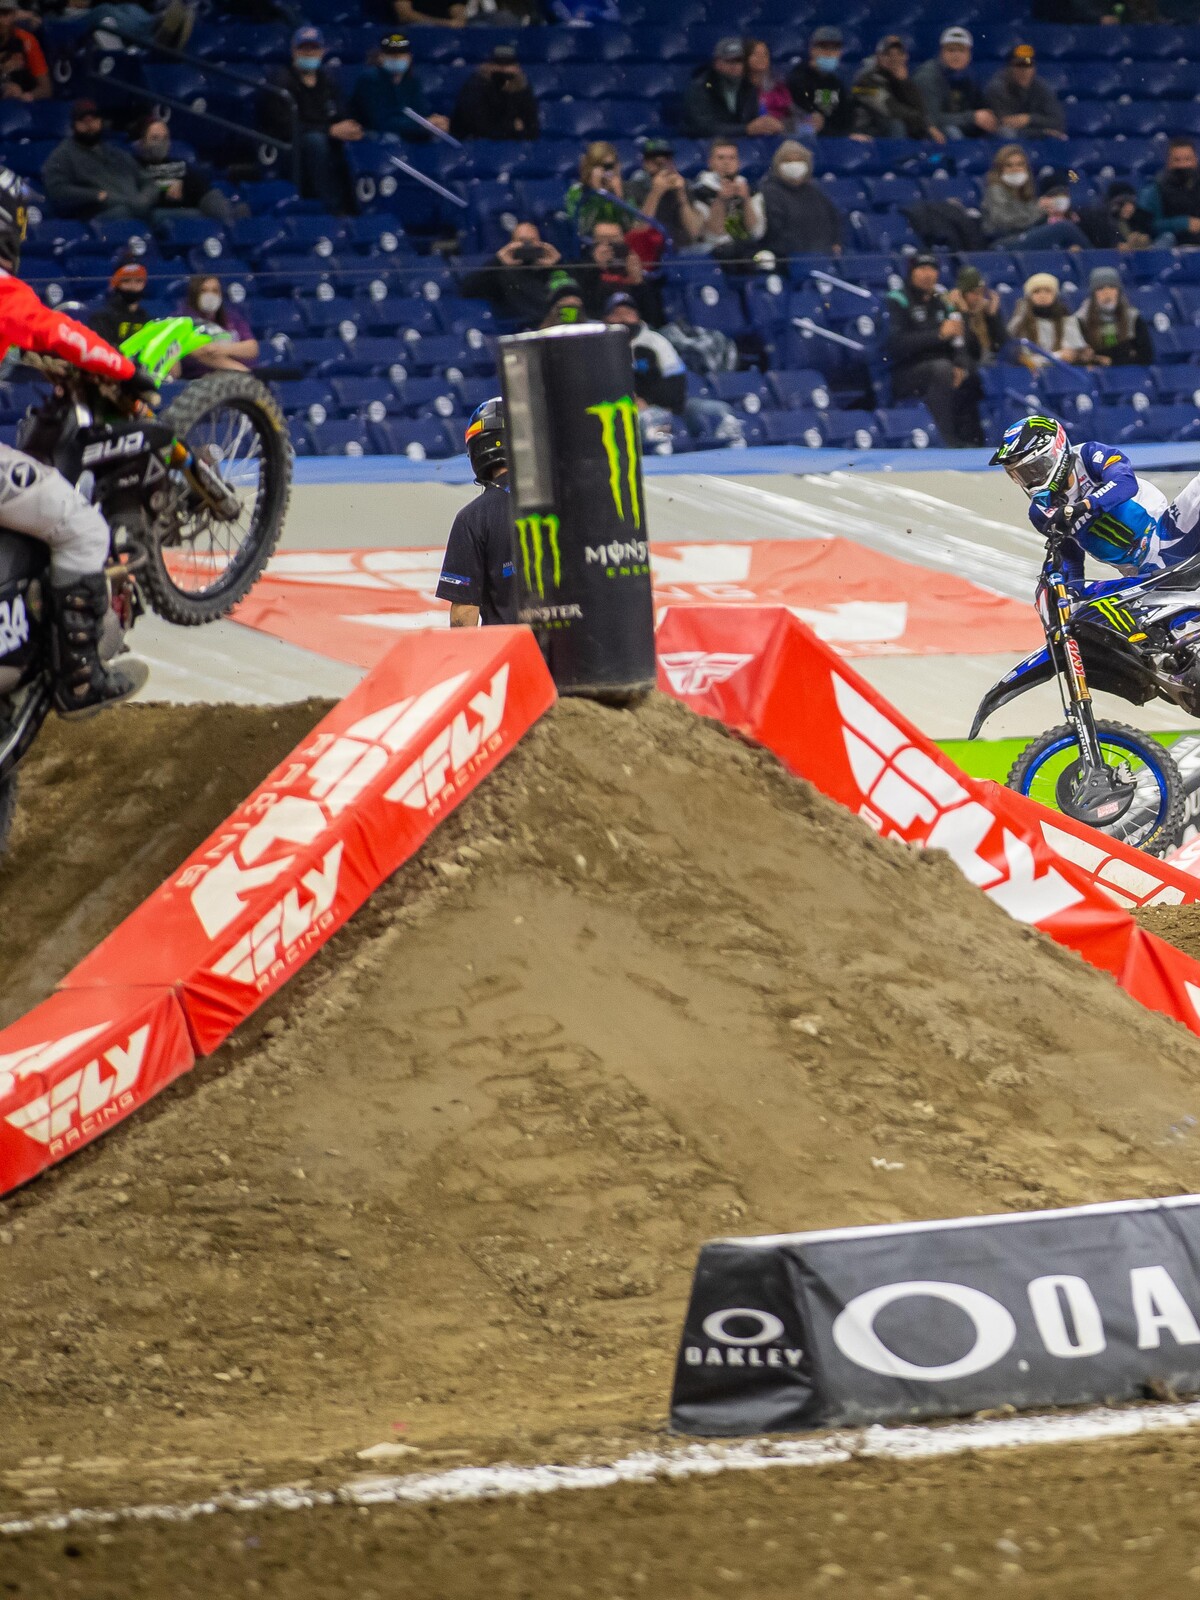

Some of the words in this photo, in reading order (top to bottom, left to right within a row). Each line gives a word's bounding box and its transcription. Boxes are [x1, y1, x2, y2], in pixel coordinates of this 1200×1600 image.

[82, 431, 145, 466] BUD
[1067, 639, 1086, 677] KYB
[383, 662, 510, 810] FLY
[427, 732, 504, 817] RACING
[1075, 716, 1091, 761] DUNLOP
[831, 669, 1086, 924] FLY
[211, 840, 344, 983] FLY
[255, 914, 336, 994] RACING
[4, 1023, 150, 1145] FLY
[51, 1089, 135, 1155] RACING
[685, 1346, 804, 1368] OAKLEY
